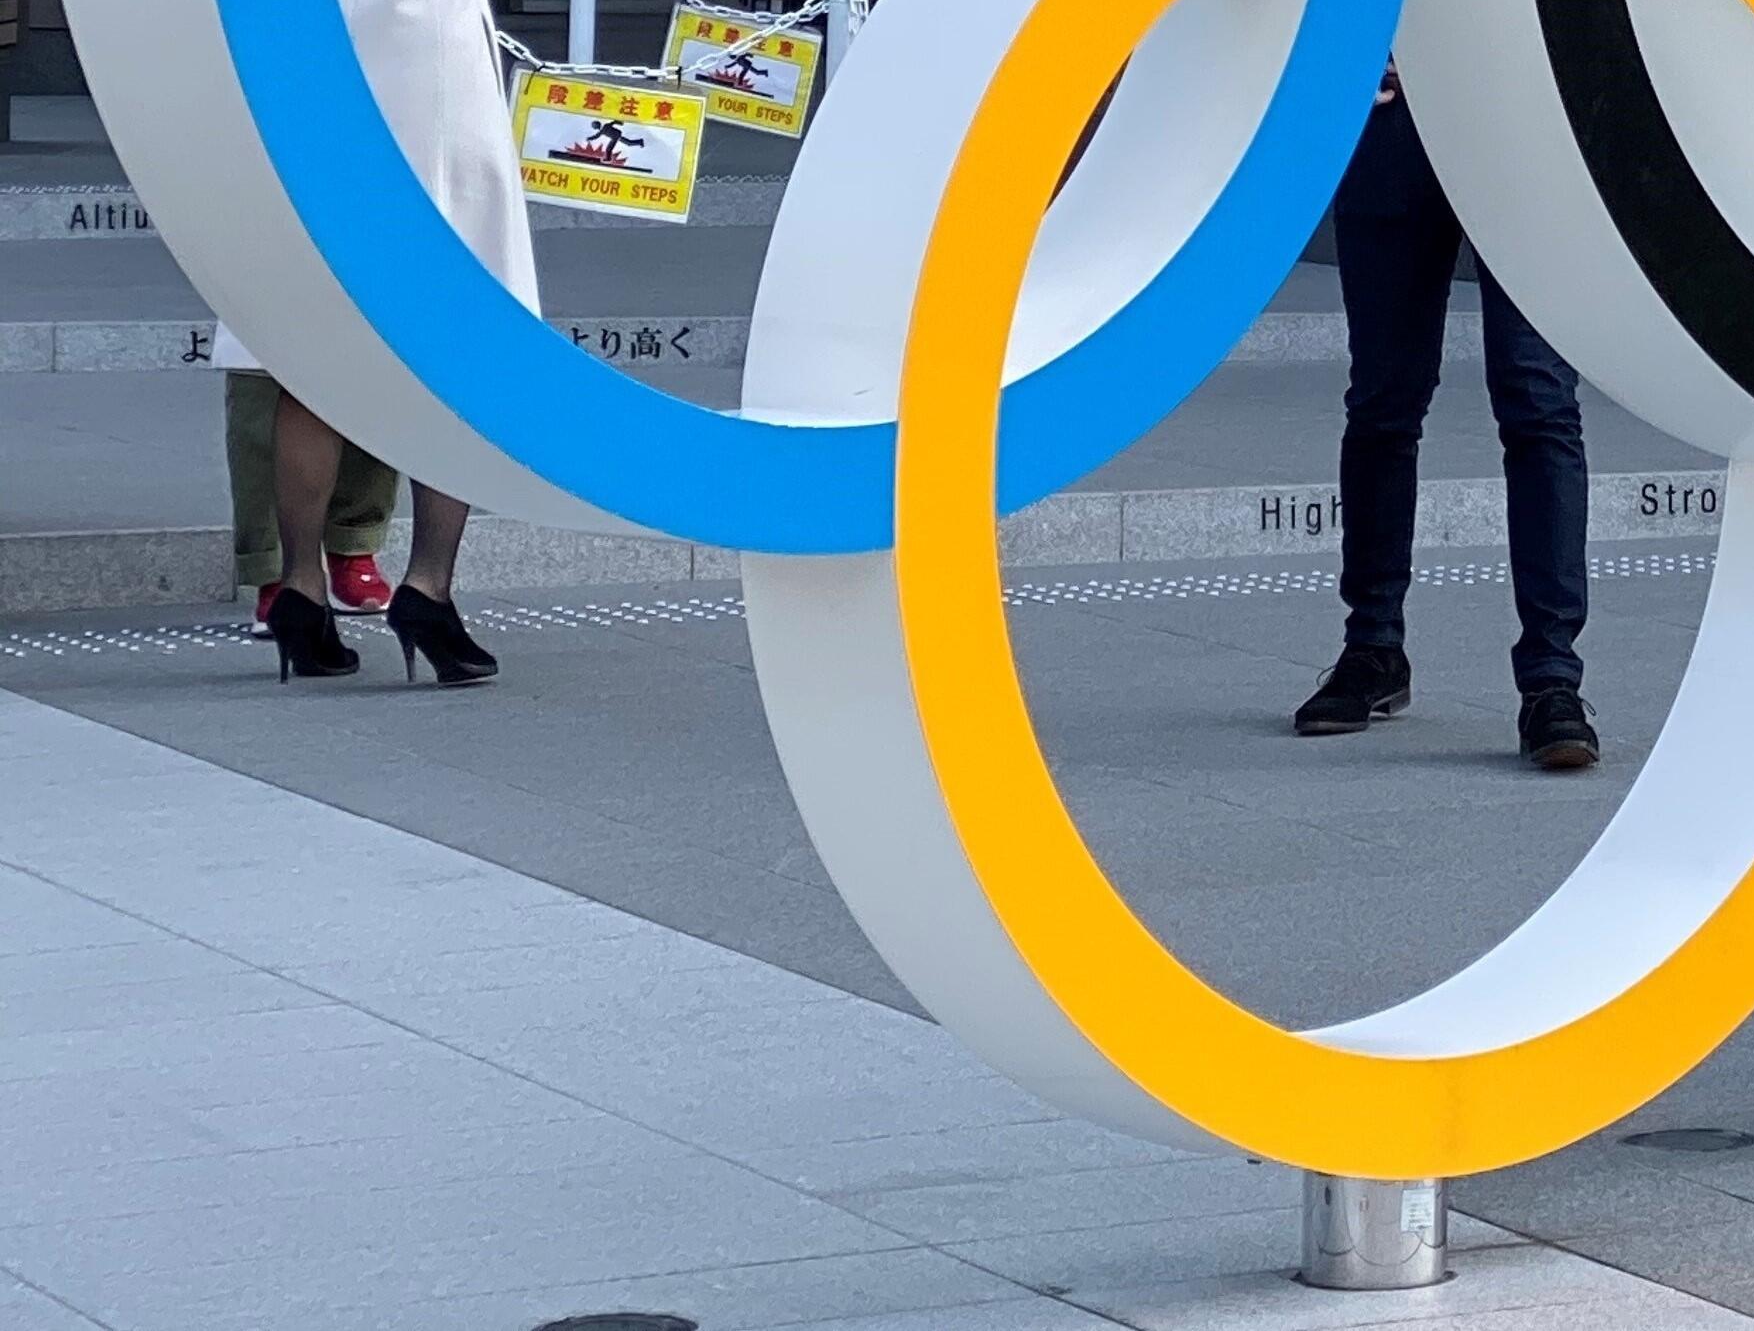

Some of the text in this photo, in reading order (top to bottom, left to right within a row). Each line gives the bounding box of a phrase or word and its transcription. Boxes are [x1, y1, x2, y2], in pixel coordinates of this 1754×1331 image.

[547, 84, 674, 120] 段差注意
[717, 96, 793, 125] YOUR STEPS
[580, 176, 620, 197] YOUR
[631, 184, 677, 204] STEPS
